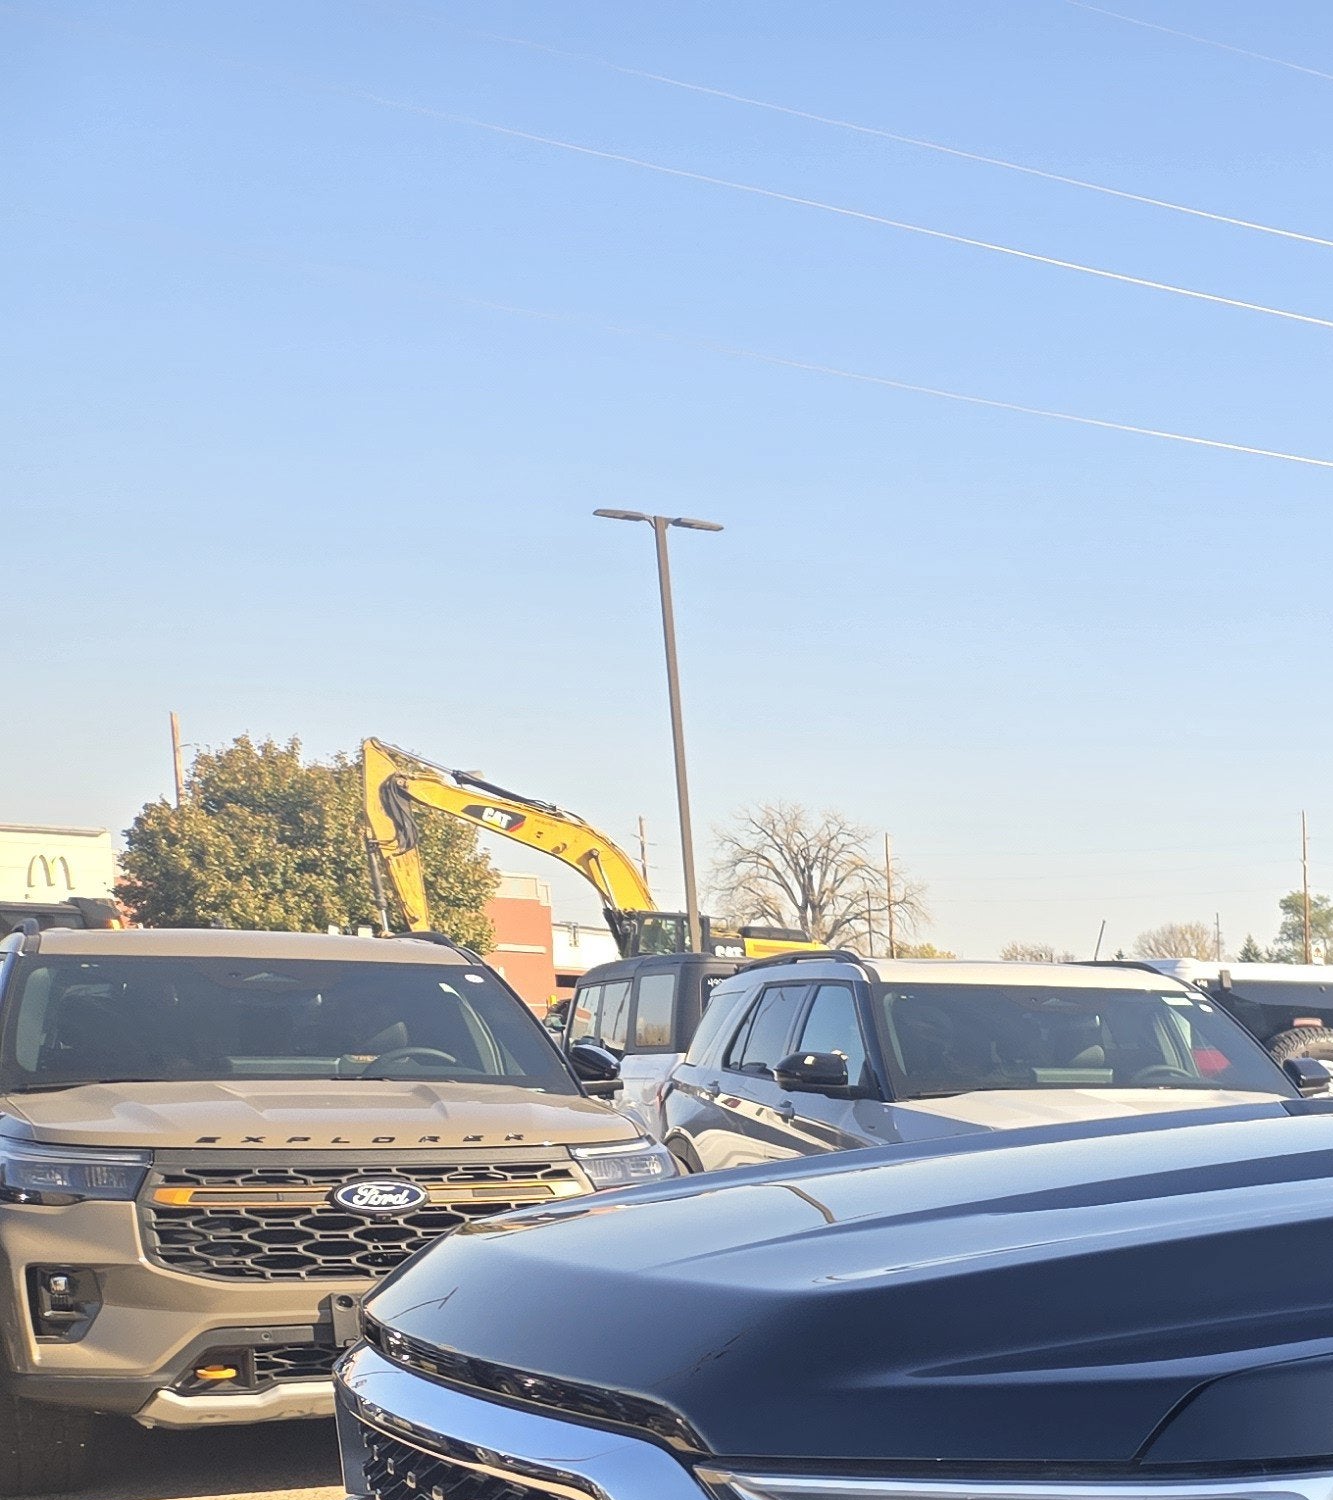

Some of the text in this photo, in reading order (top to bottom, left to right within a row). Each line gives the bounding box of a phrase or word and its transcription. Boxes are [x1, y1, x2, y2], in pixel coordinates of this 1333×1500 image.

[481, 807, 512, 829] CAT
[195, 1132, 525, 1143] EXPLORER
[352, 1184, 410, 1206] Ford
